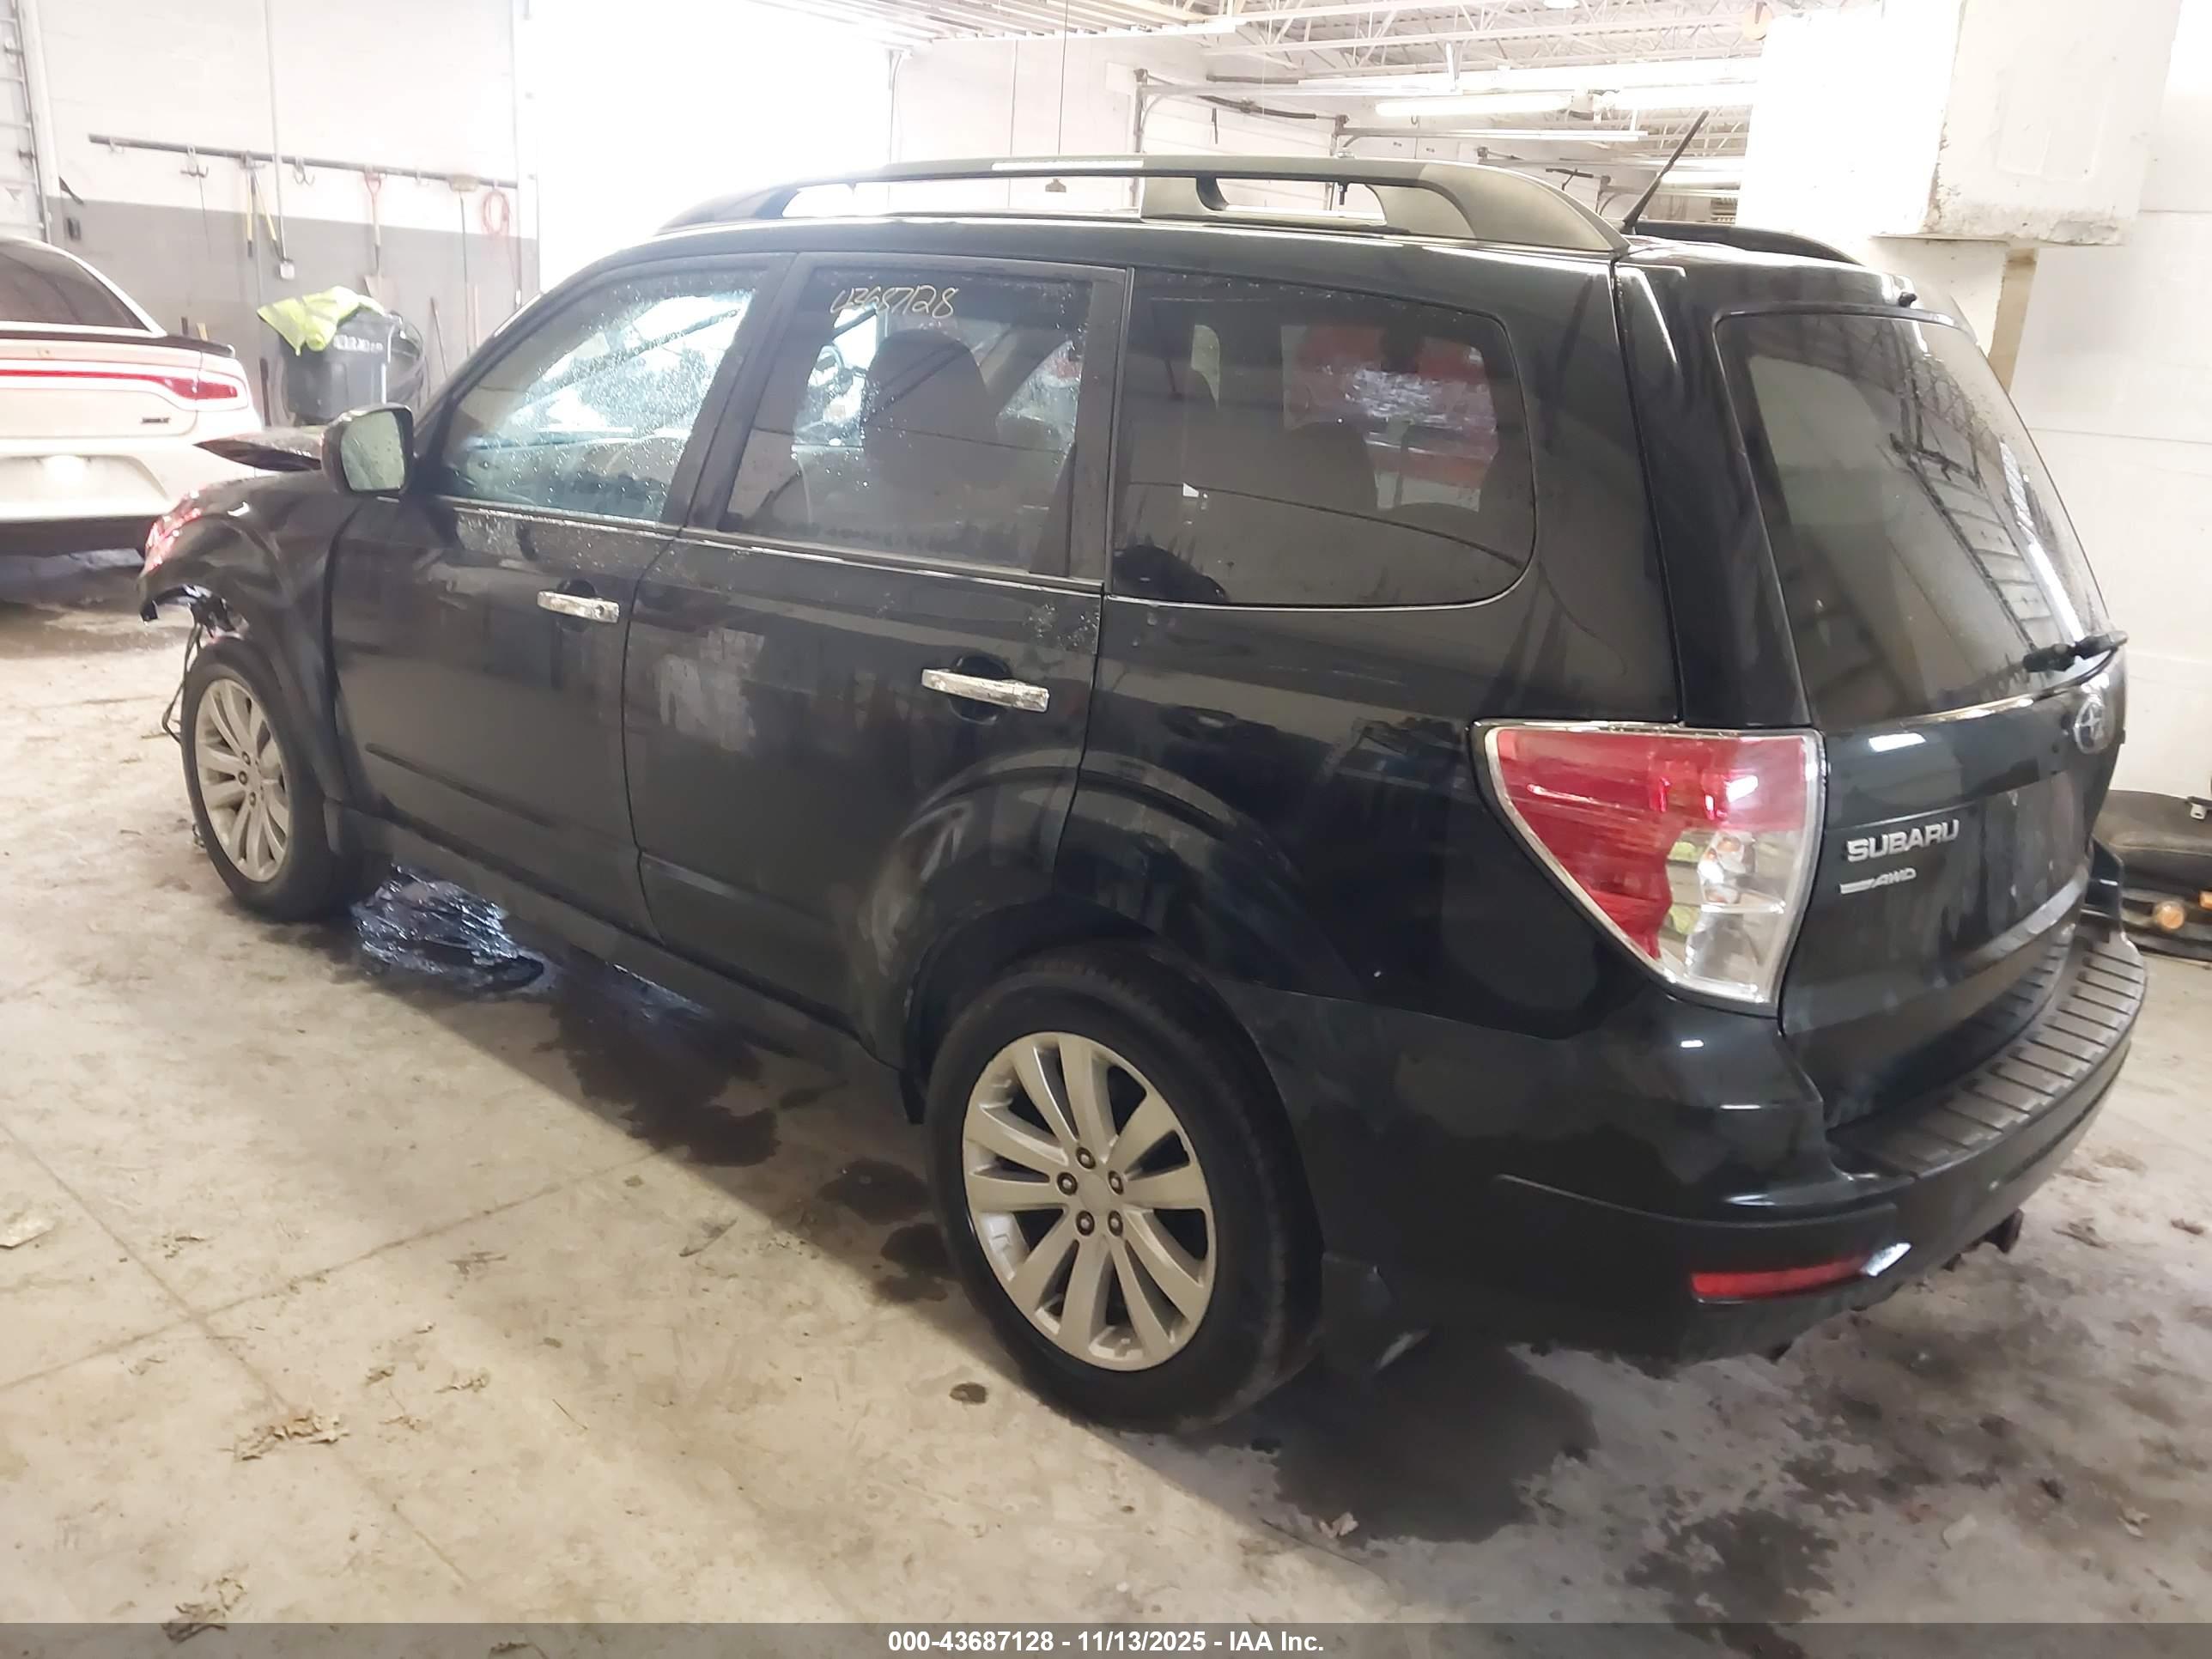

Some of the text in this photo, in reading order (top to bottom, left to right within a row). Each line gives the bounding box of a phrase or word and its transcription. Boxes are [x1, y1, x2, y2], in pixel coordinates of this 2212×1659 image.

[830, 285, 959, 319] 43687128
[1847, 818, 1960, 862] SUBARU
[1872, 867, 1917, 888] AWD
